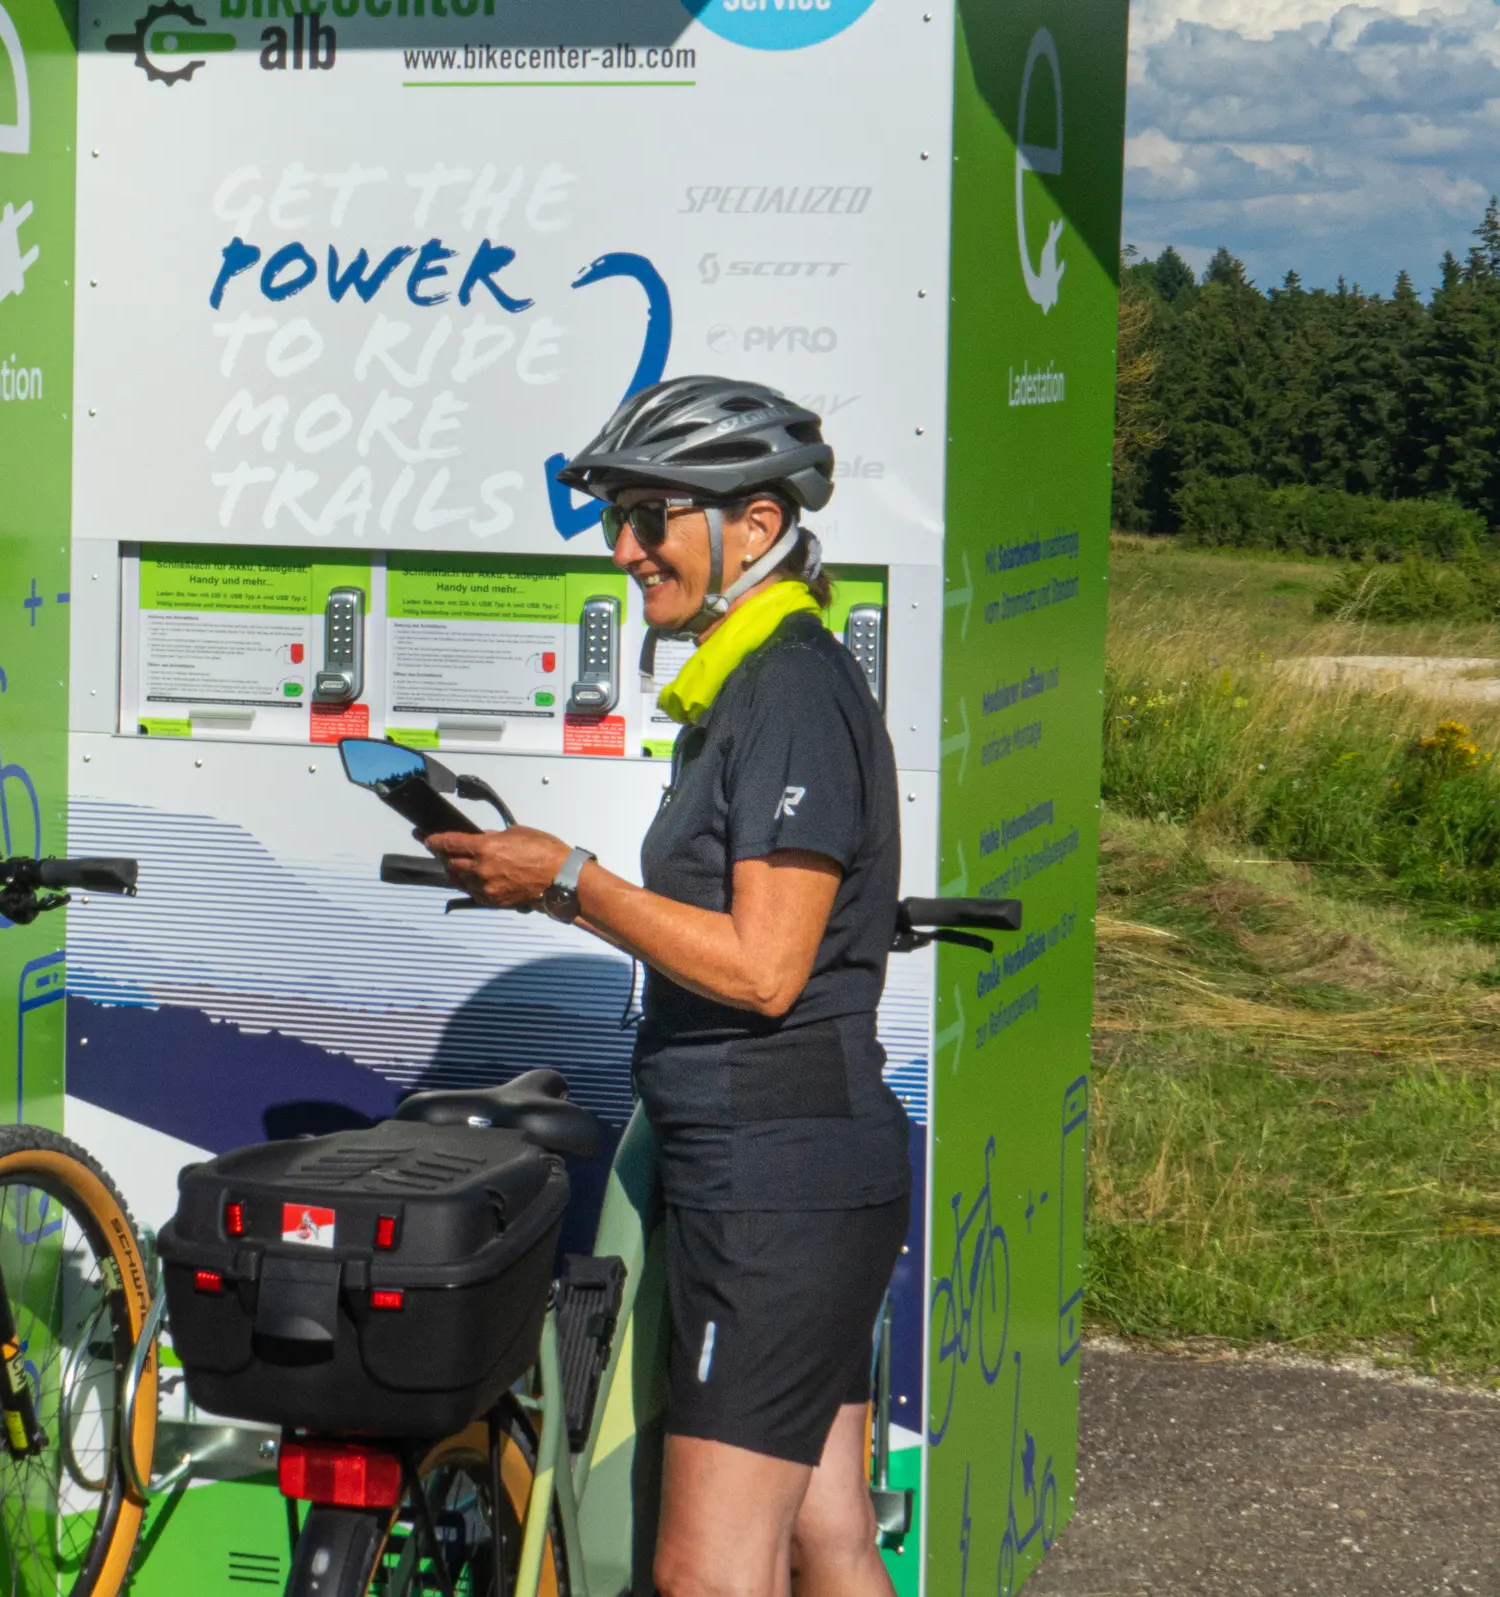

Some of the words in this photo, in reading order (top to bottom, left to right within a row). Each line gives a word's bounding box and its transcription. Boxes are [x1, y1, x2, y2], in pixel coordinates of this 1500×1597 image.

[259, 12, 337, 70] alb
[403, 44, 696, 70] www.bikecenter-alb.com
[212, 162, 389, 240] GET
[405, 162, 581, 239] THE
[677, 185, 873, 215] SPECIALIZED
[209, 236, 536, 313] POWER
[725, 260, 850, 277] SCOTT
[211, 311, 325, 379] TO
[354, 312, 569, 388] RIDE
[743, 326, 838, 354] PYRO
[1008, 359, 1066, 407] Ladestation
[205, 389, 473, 465] MORE
[210, 461, 524, 538] TRAILS
[189, 575, 219, 587] Handy
[222, 576, 240, 585] und
[436, 582, 467, 594] Handy
[470, 583, 489, 593] und
